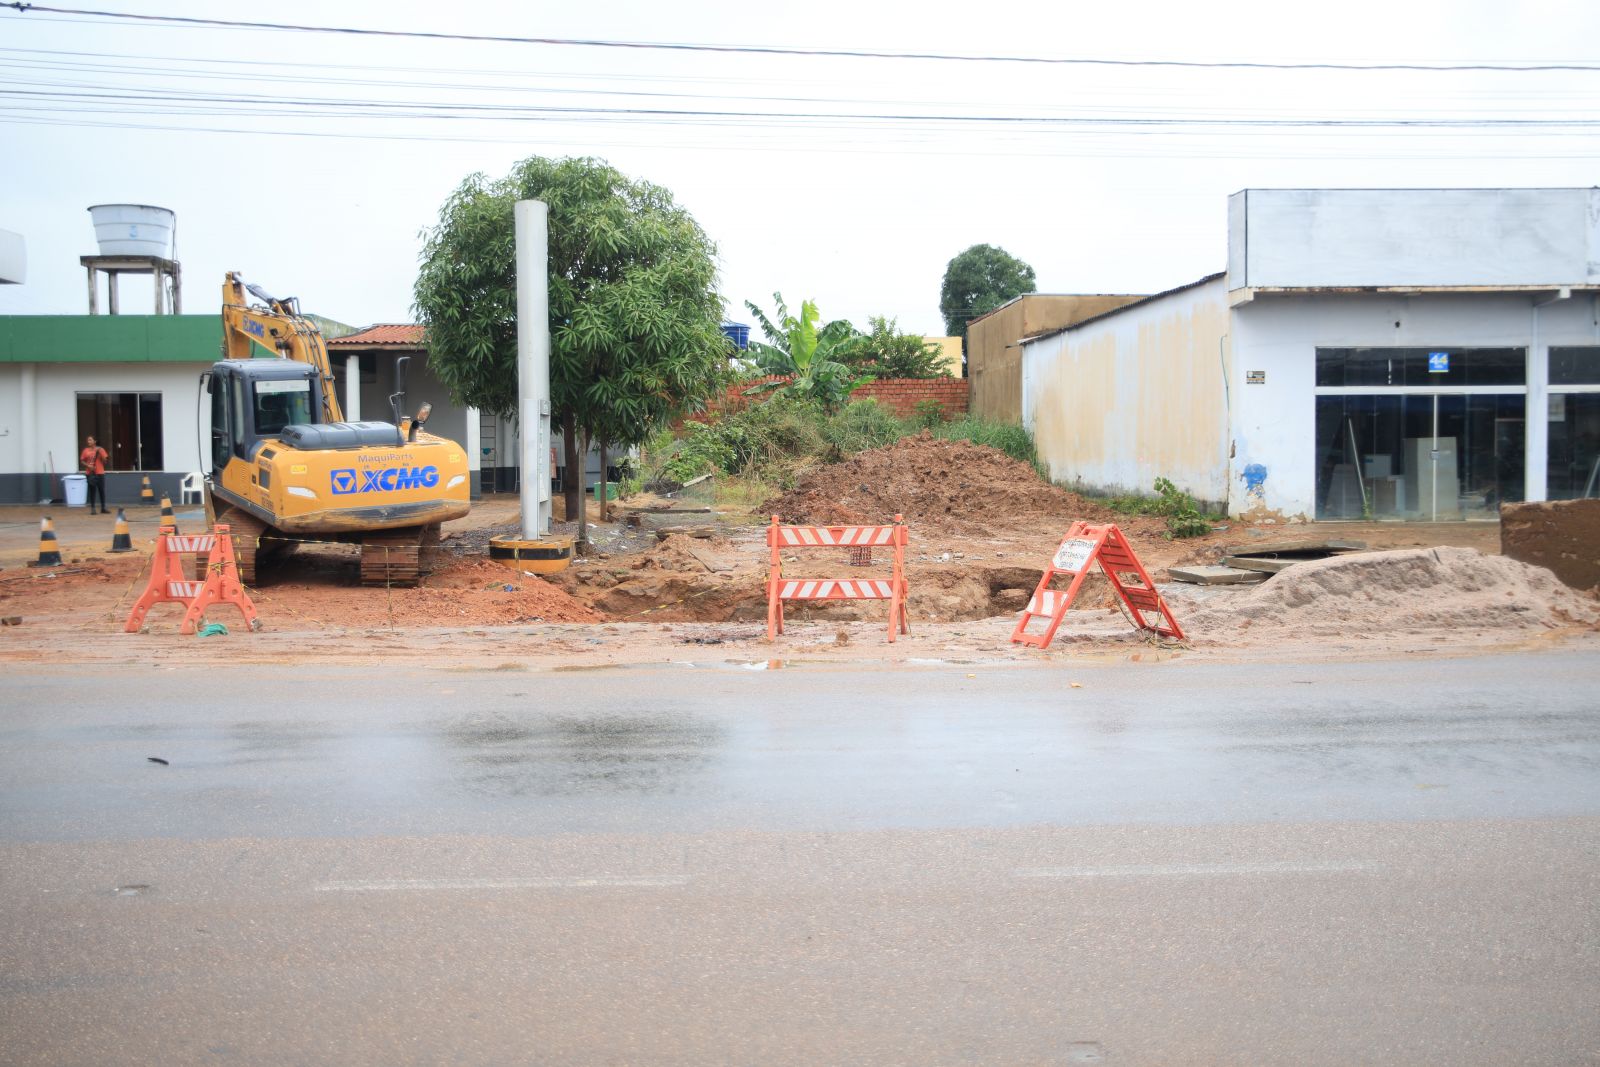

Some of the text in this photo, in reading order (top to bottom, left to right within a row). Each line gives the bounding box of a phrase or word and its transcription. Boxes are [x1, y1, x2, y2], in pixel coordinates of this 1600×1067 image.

[1429, 354, 1448, 365] 44
[358, 453, 414, 464] MaquiParts
[359, 465, 440, 493] XCMG
